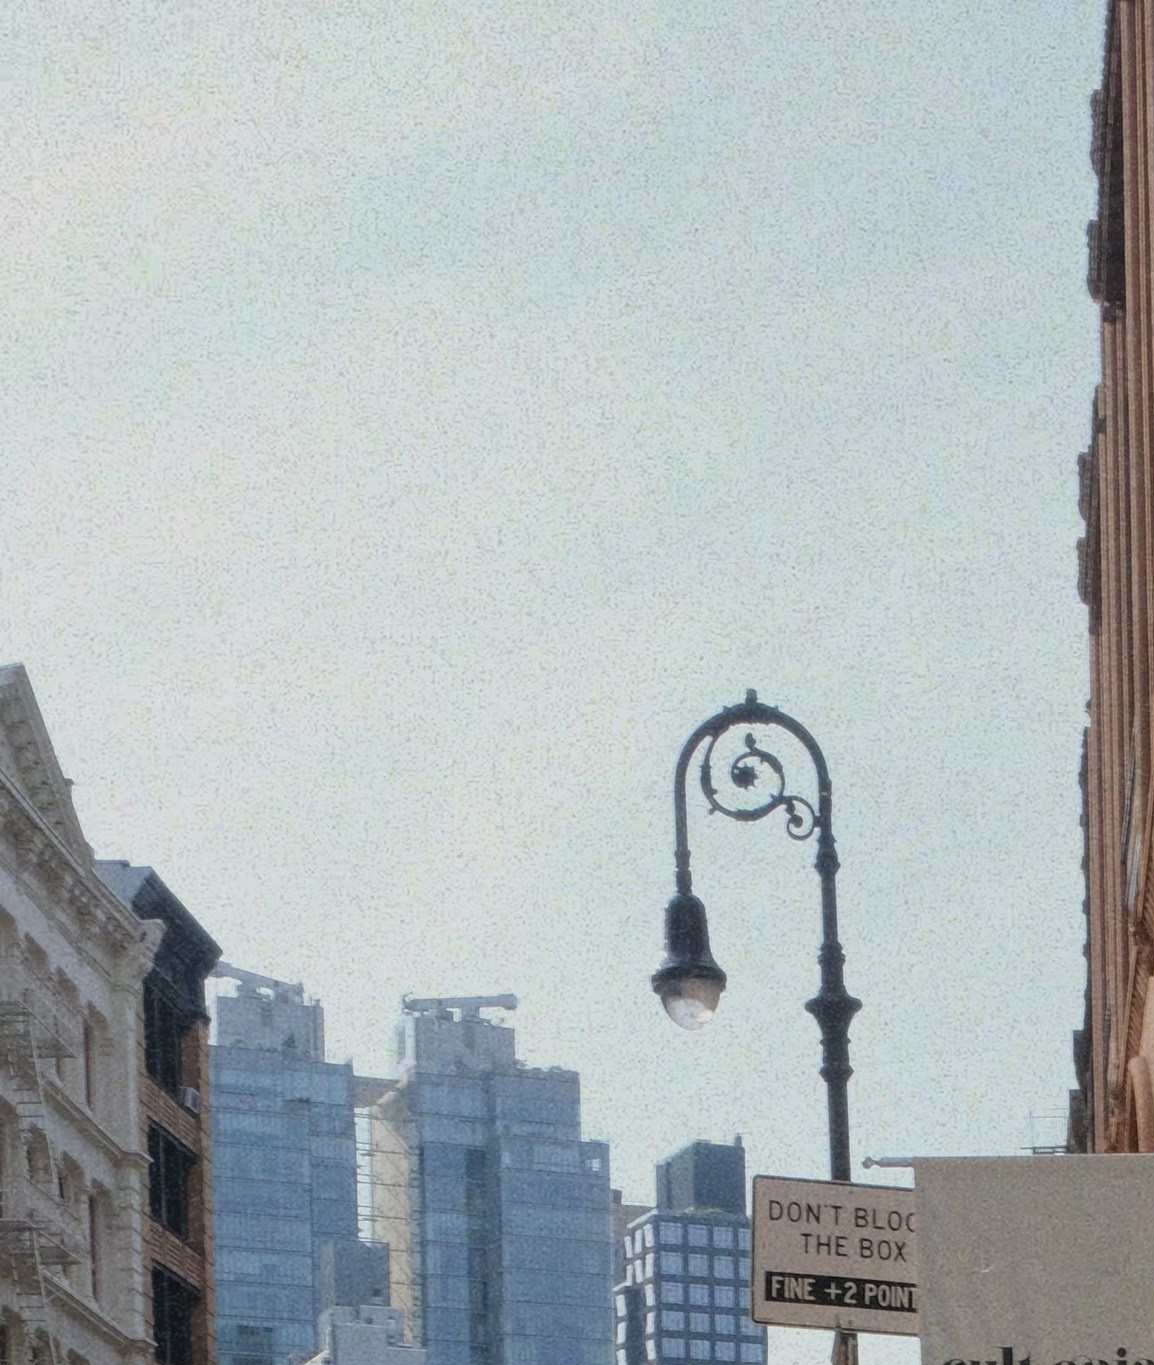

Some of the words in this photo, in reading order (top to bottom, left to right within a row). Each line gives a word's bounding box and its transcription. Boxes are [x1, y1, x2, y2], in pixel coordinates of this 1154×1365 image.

[769, 1200, 843, 1226] DON'T
[854, 1207, 915, 1233] BLOC
[800, 1233, 848, 1257] THE
[859, 1237, 907, 1263] BOX
[771, 1275, 816, 1301] FINE
[824, 1281, 858, 1304] +2
[863, 1283, 918, 1310] POINT
